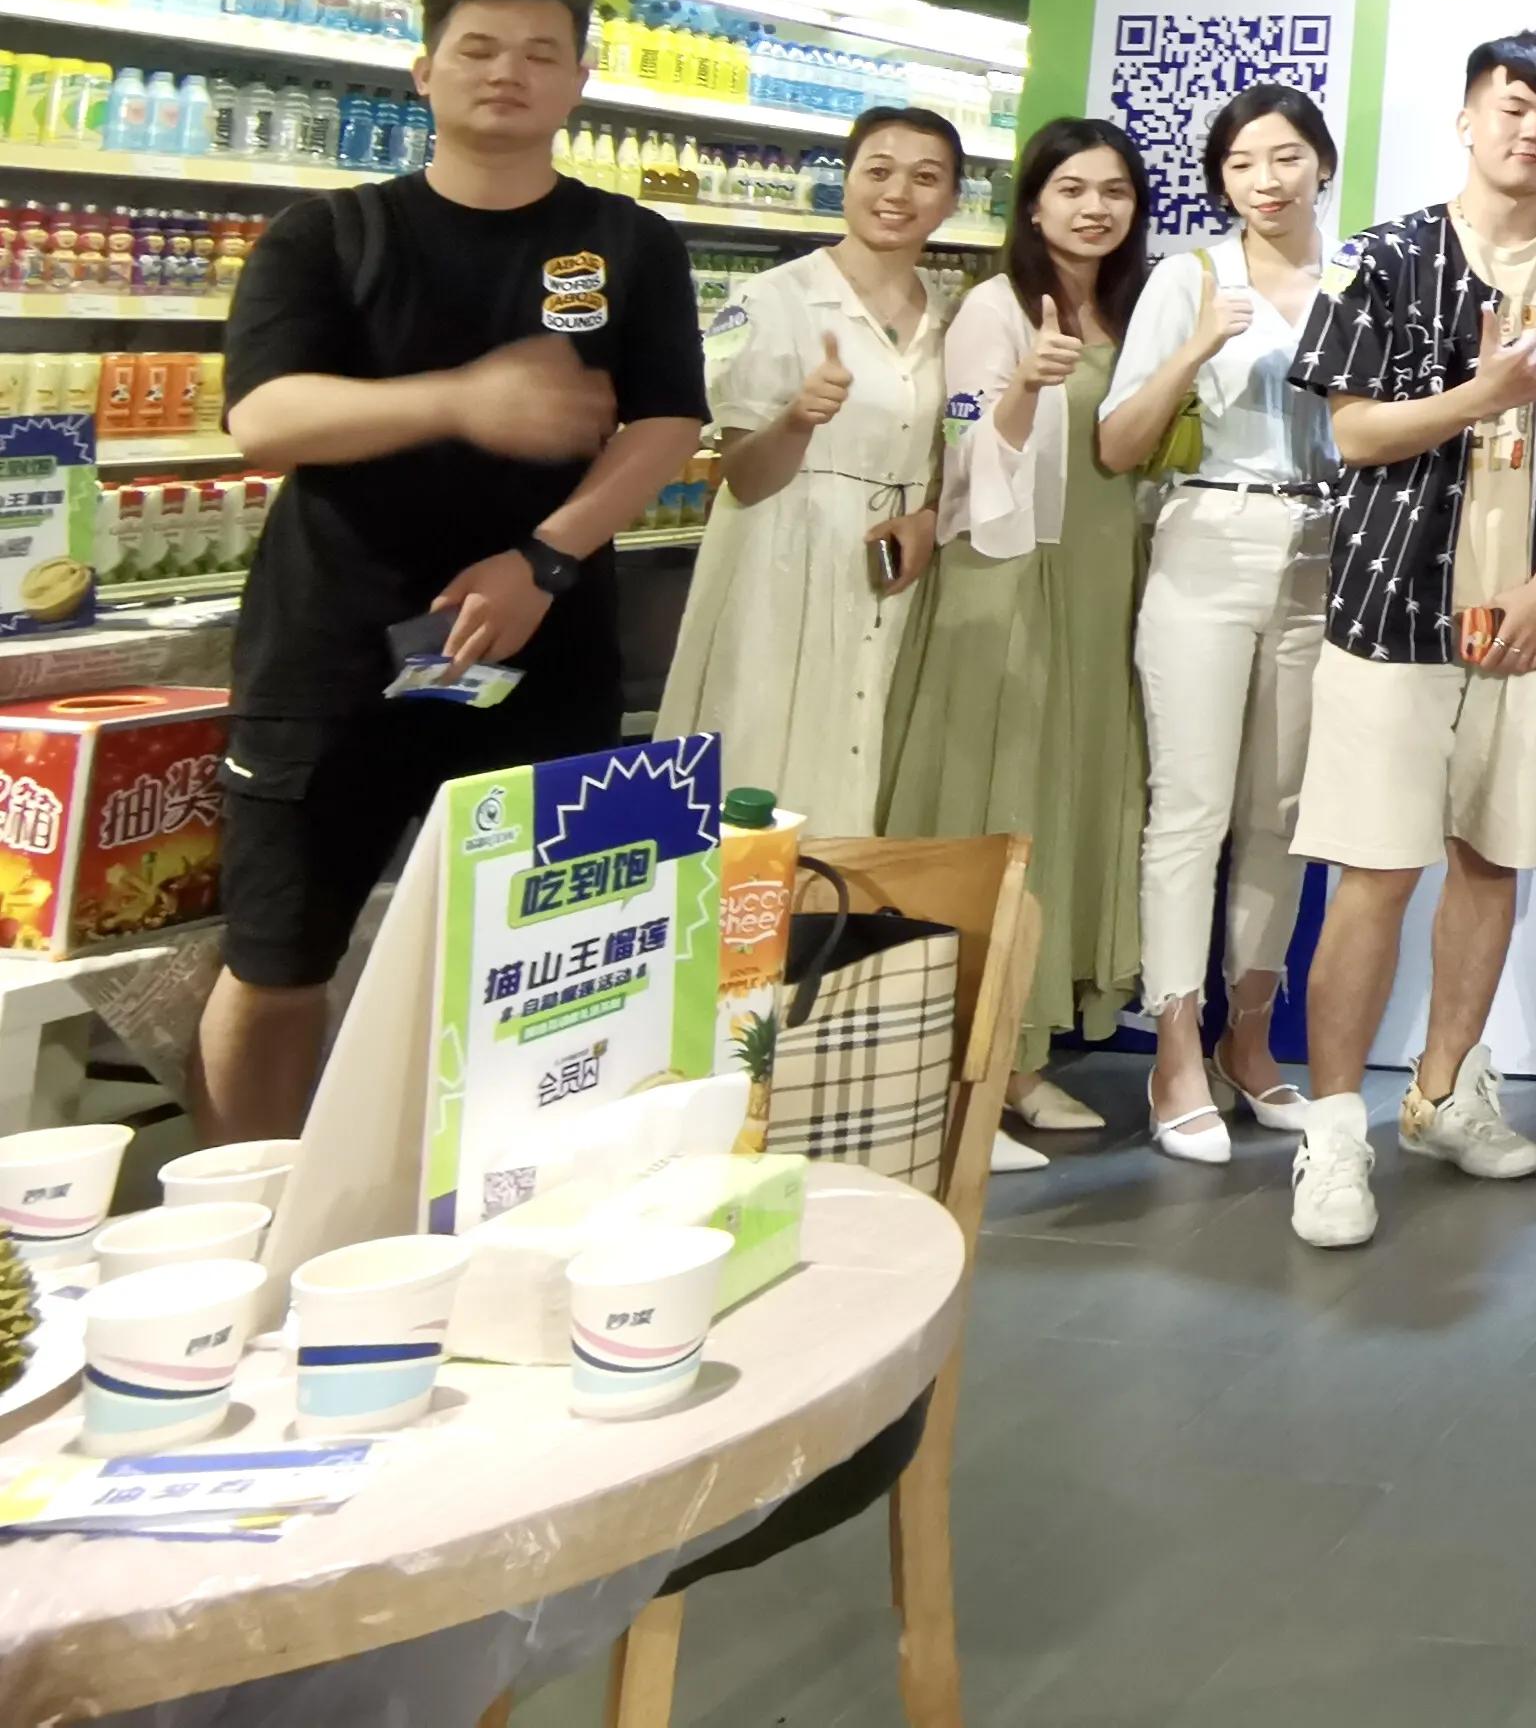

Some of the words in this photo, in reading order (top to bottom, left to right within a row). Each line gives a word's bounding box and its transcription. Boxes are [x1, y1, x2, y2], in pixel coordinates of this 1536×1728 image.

[949, 401, 977, 419] VIP
[98, 754, 225, 850] 抽奖
[521, 848, 651, 918] 吃到饱
[483, 916, 670, 1004] 猫山王榴莲
